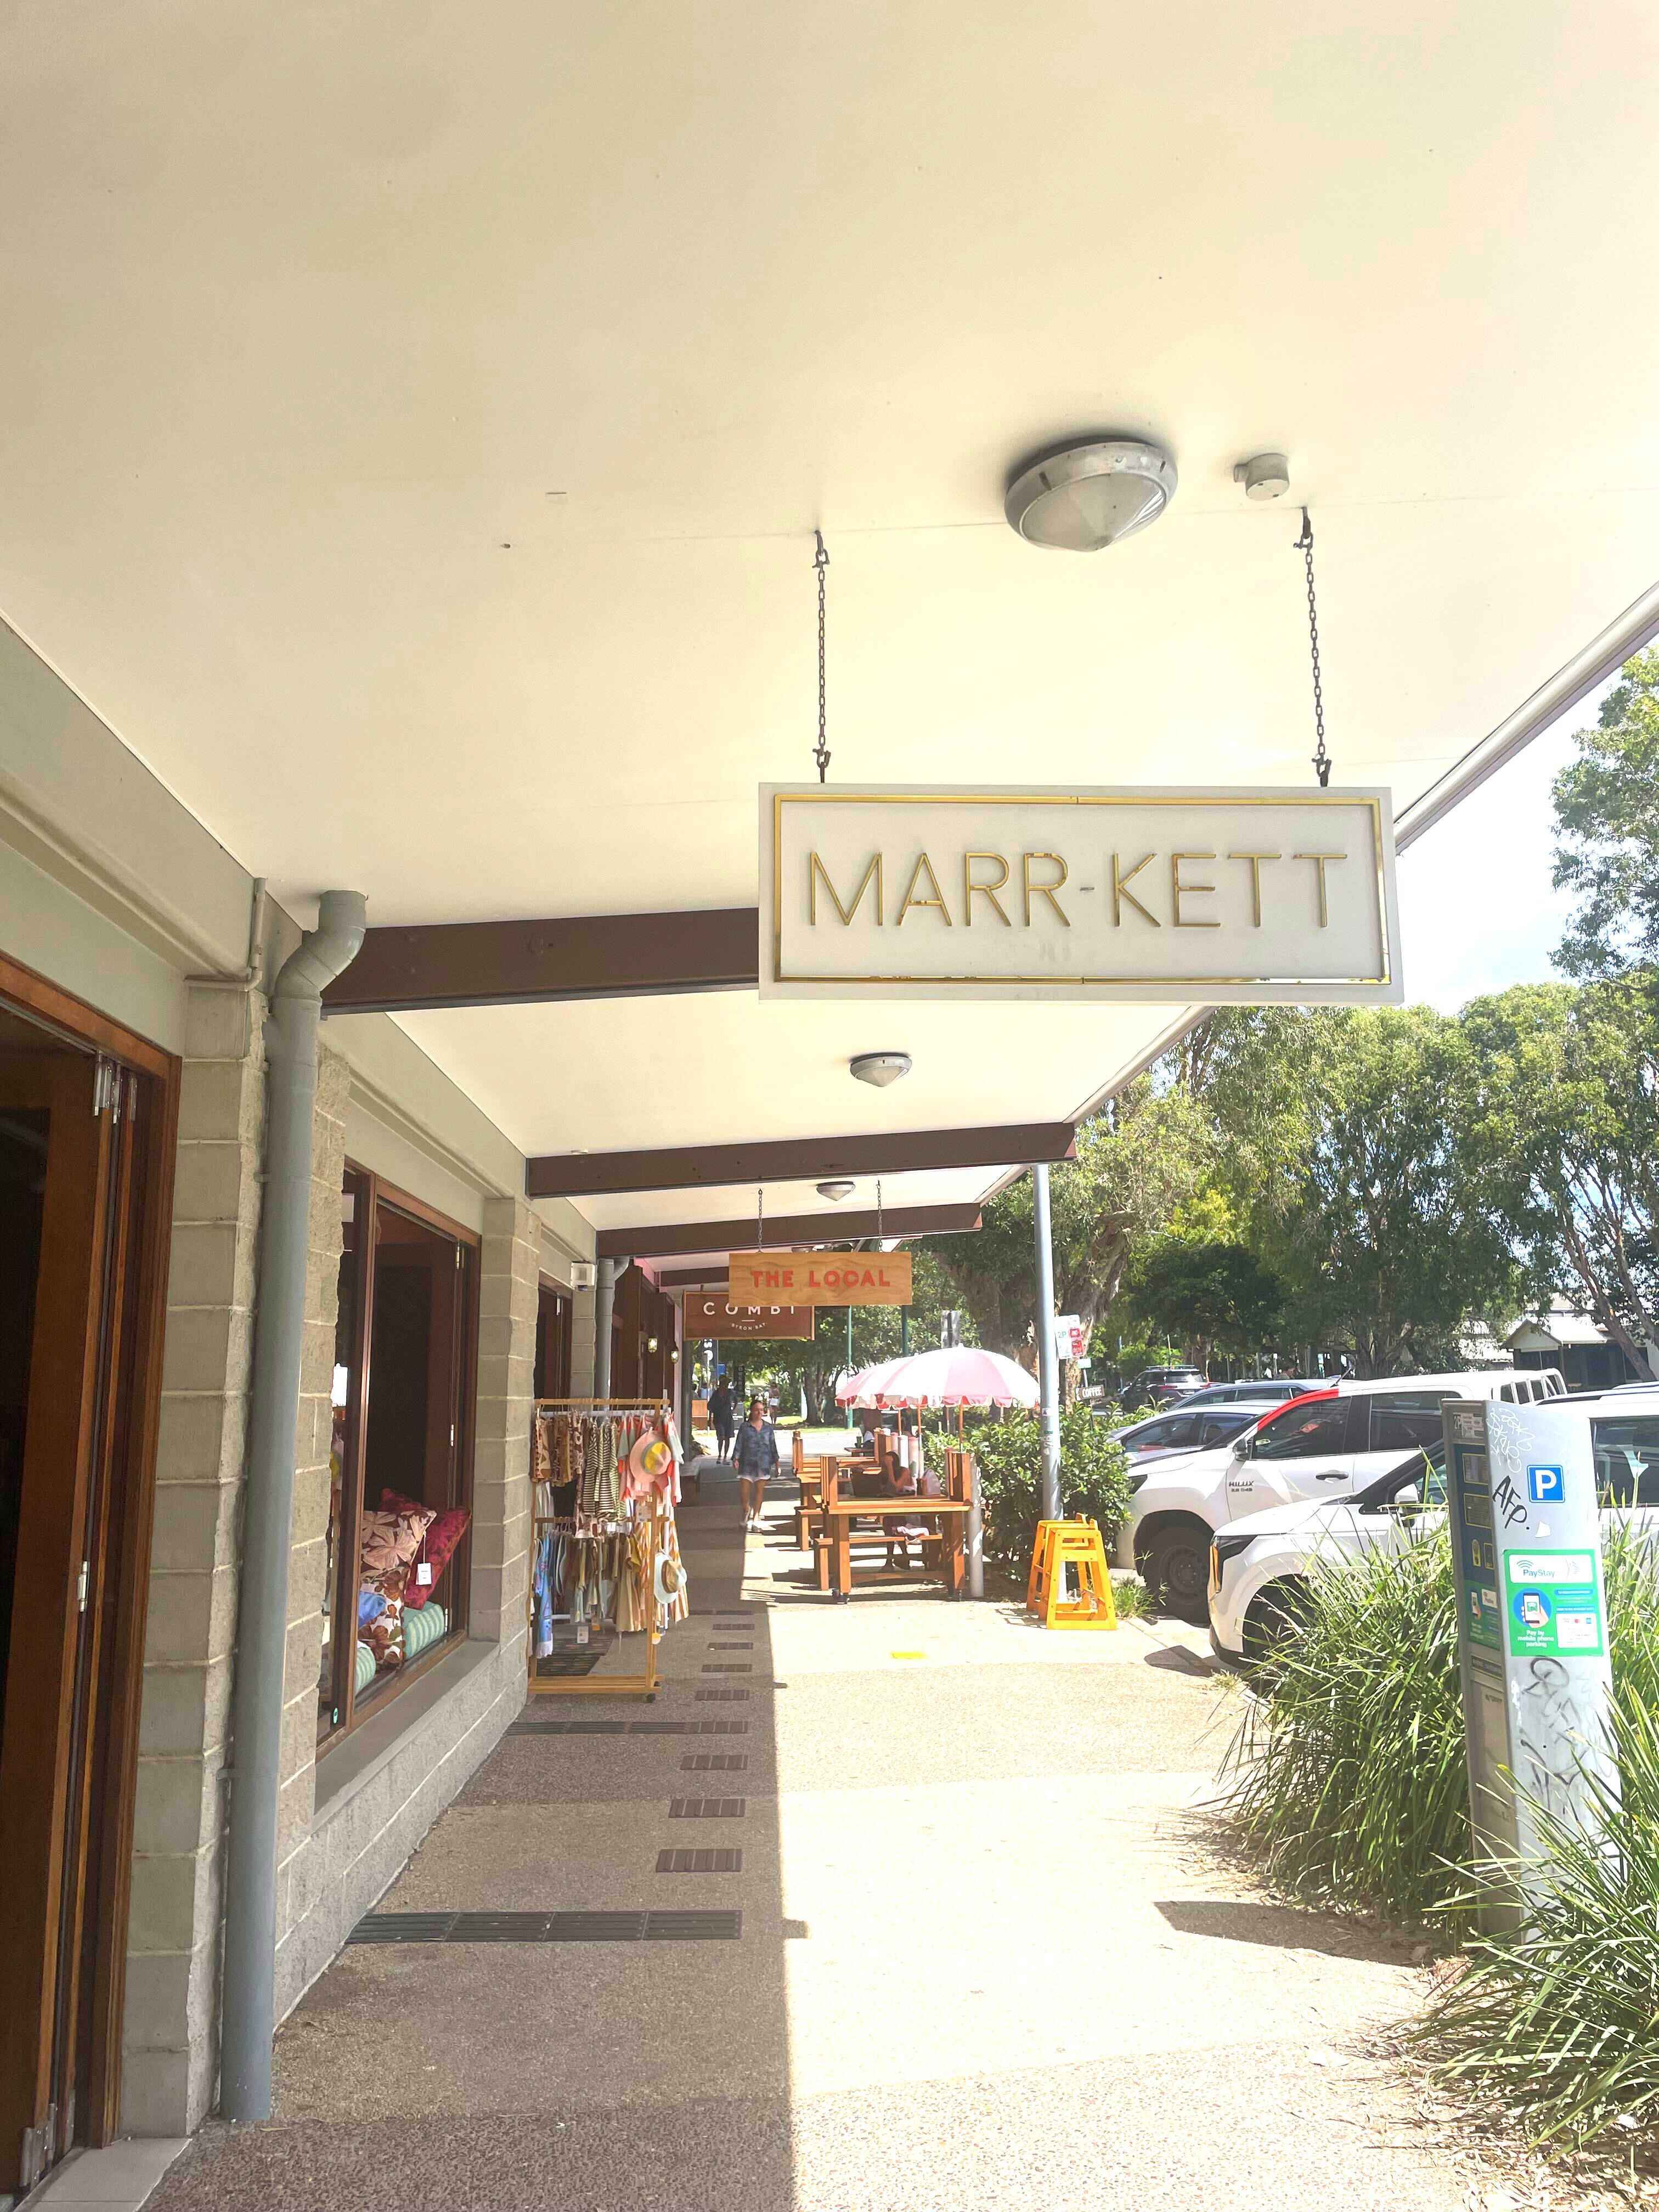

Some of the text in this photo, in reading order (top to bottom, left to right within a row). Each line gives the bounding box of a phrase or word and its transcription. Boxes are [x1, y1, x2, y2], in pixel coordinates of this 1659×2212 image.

[809, 851, 1347, 928] MARR-KETT
[751, 1269, 890, 1288] THE LOCAL
[703, 1302, 794, 1314] COMBI
[1535, 1470, 1556, 1499] P
